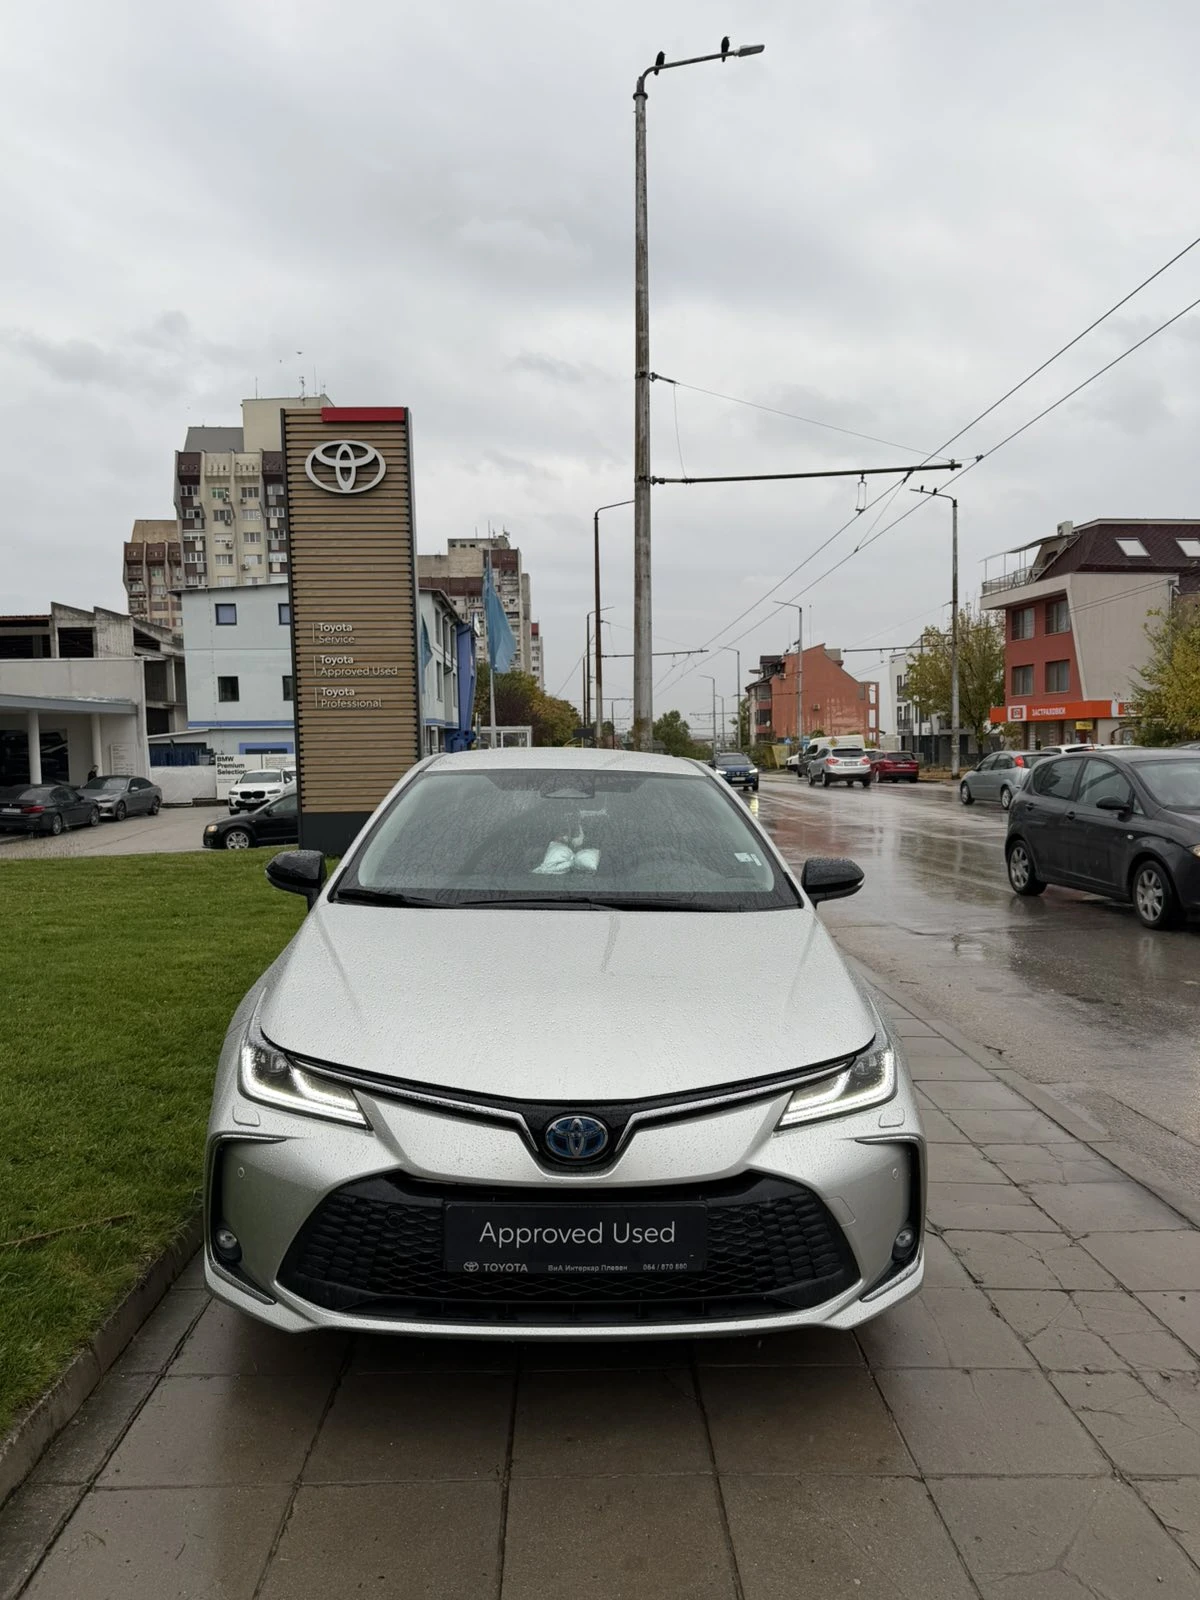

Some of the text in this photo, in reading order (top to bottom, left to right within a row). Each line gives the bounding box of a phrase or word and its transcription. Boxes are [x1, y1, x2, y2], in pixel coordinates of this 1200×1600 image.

[318, 623, 353, 634] Toyota
[319, 635, 355, 644] Service
[320, 655, 354, 666] Toyota
[320, 666, 398, 677] Approved Used
[321, 687, 355, 698] Toyota
[321, 698, 382, 708] Professional
[479, 1221, 675, 1248] Approved Used
[483, 1263, 528, 1273] TOYOTA
[565, 1264, 600, 1273] Интеркар
[601, 1264, 628, 1272] Плевен
